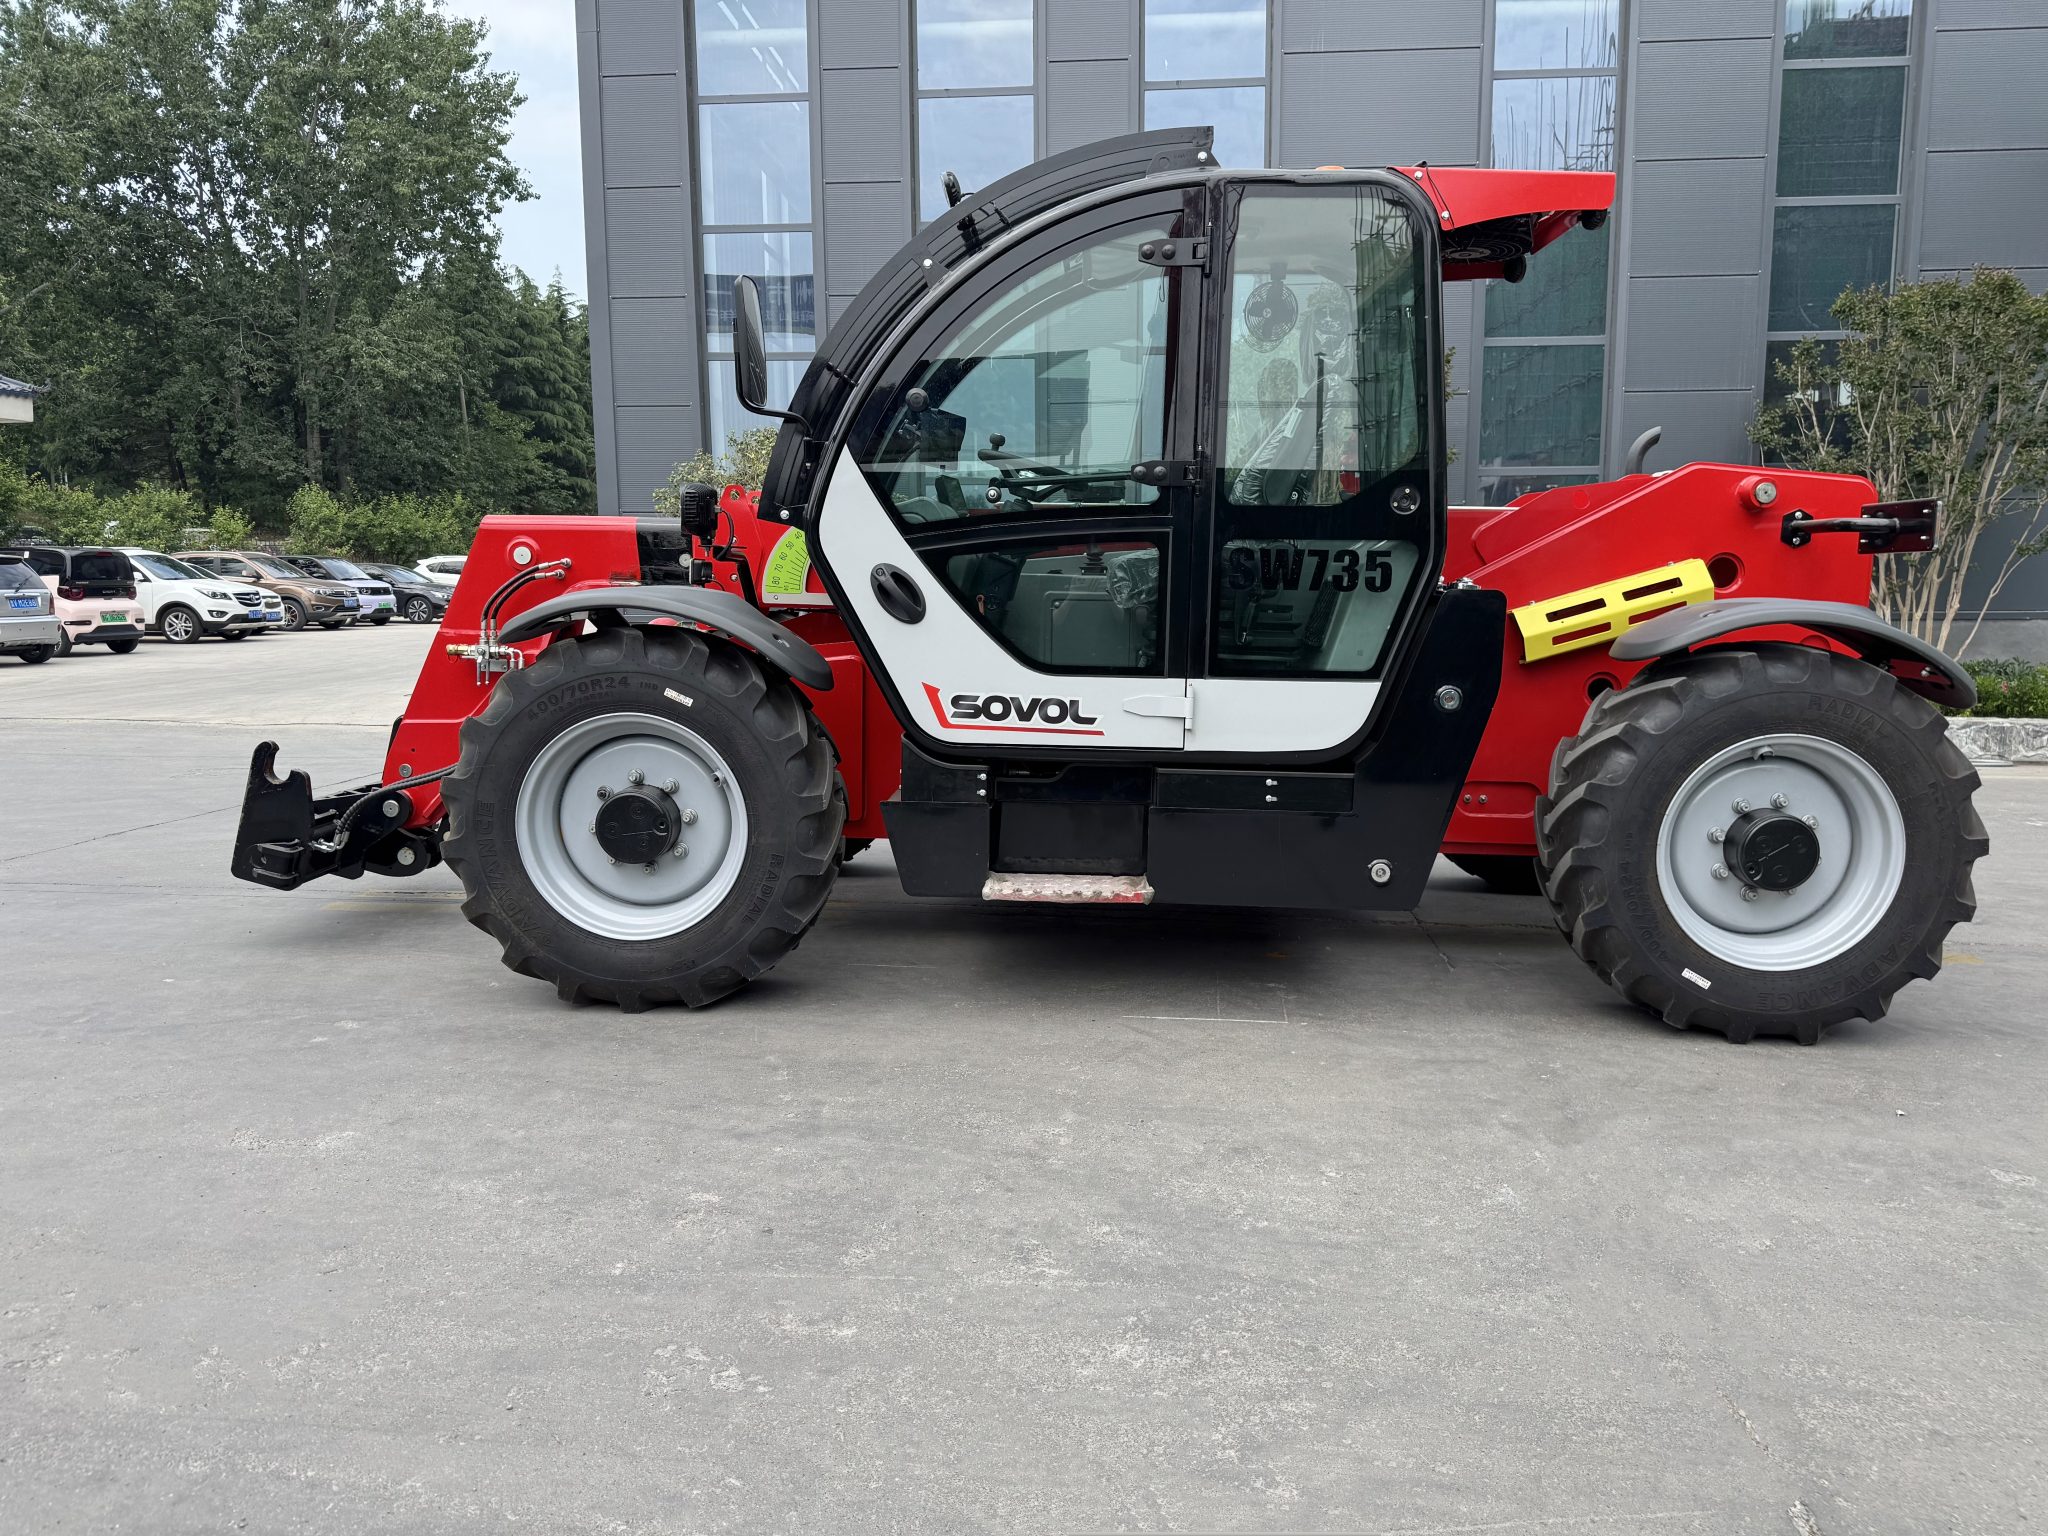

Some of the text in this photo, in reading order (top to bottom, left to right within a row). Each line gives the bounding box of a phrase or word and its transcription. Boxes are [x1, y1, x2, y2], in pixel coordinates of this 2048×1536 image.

[786, 541, 794, 550] 50
[795, 531, 803, 539] 40
[774, 563, 783, 572] 70
[779, 552, 788, 560] 60
[1228, 547, 1393, 593] SW735
[772, 576, 781, 585] 80
[527, 676, 631, 720] 400/70R24
[950, 694, 1098, 725] SOVOL
[1808, 695, 1889, 738] RADIAL
[478, 800, 538, 931] ADVANCE
[743, 853, 785, 922] RADIAL
[1755, 944, 1898, 1010] ADVANCE
